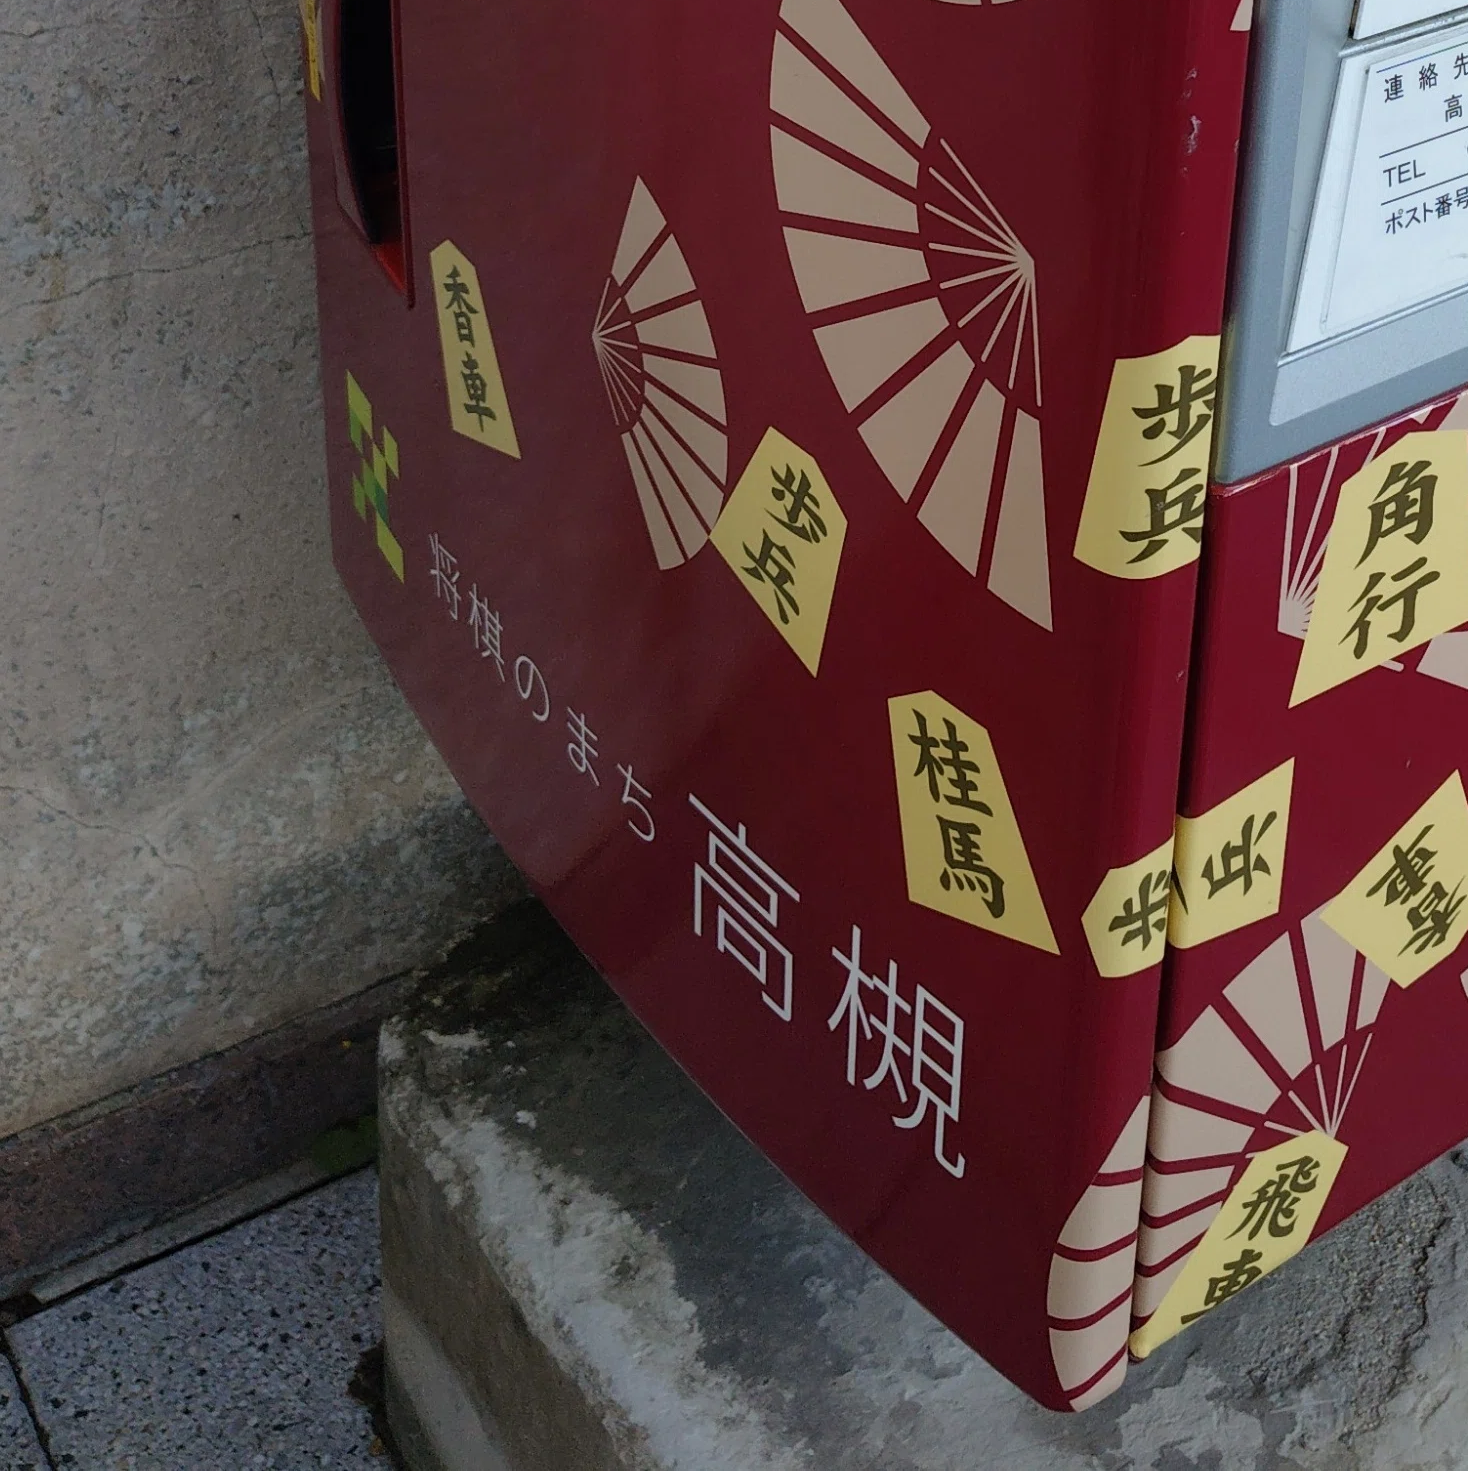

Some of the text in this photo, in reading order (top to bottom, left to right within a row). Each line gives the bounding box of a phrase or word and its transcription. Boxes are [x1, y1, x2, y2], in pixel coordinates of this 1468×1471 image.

[1383, 159, 1426, 187] TEL
[444, 264, 495, 434] 香車
[740, 462, 828, 626] 歩兵
[1118, 364, 1216, 565] 歩兵
[1338, 459, 1441, 660] 角行
[427, 532, 658, 843] 将棋のまち
[908, 707, 1005, 919] 桂馬
[1366, 823, 1468, 958] 香車
[688, 792, 966, 1180] 高槻
